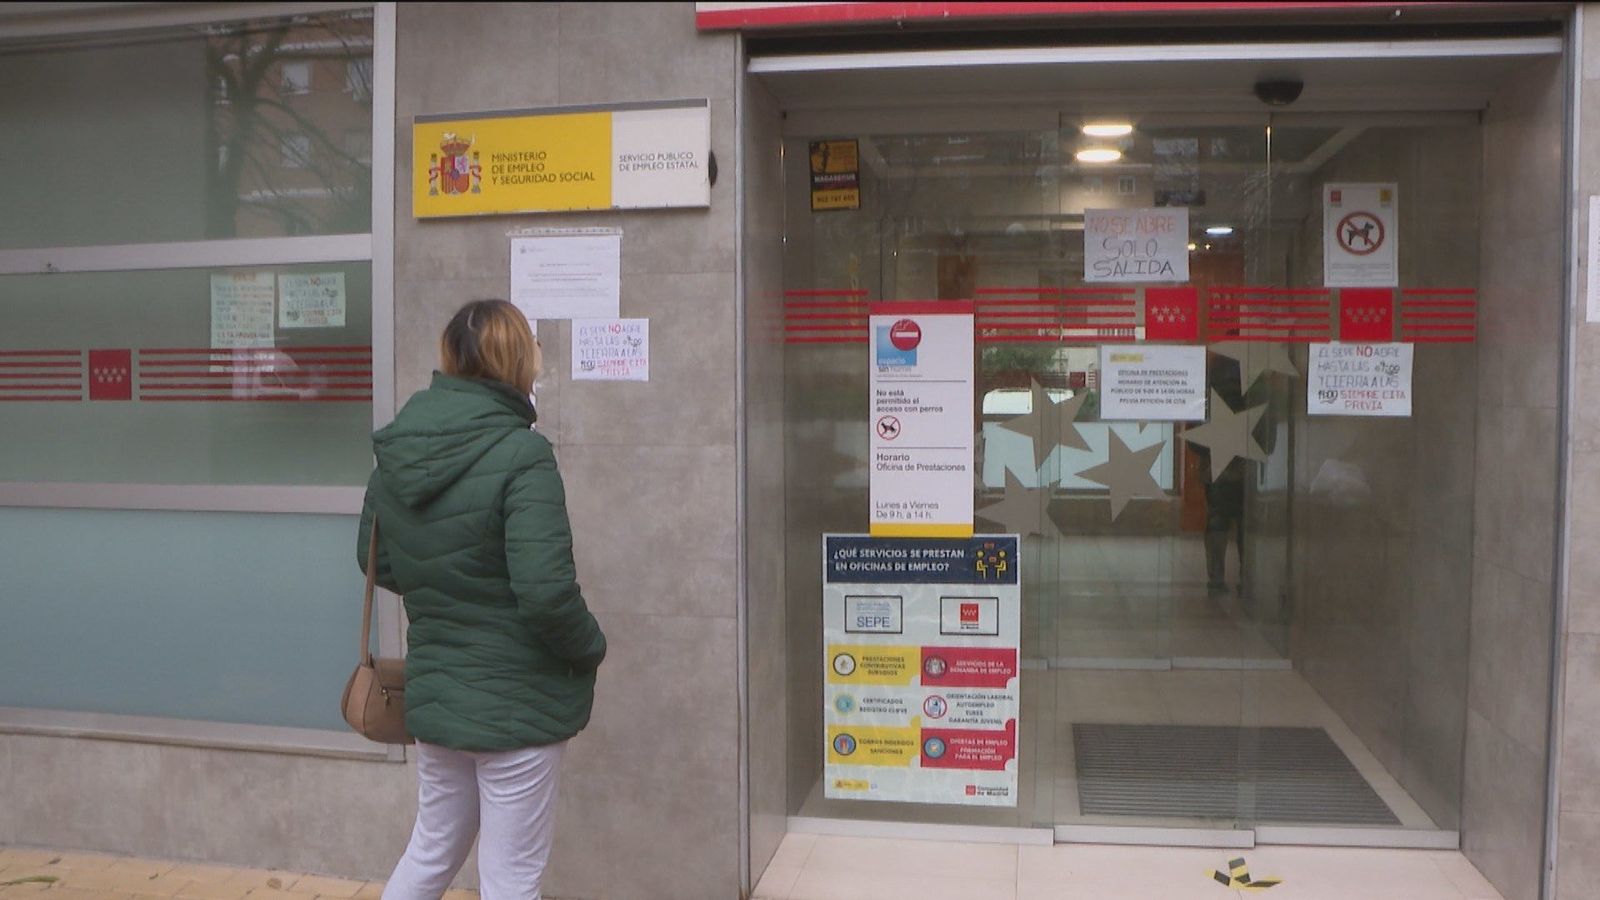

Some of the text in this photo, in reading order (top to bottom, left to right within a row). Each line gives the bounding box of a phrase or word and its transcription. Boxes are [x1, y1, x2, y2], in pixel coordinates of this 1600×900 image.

[491, 151, 547, 163] MINISTERIO
[618, 153, 655, 163] SERVICIO
[491, 162, 545, 175] DE EMPLEO
[618, 159, 700, 172] DE EMPLEO ESTATAL
[491, 171, 596, 185] Y SEGURIDAD SOCIAL
[1136, 215, 1176, 233] ABRE
[1103, 236, 1158, 261] SOLO
[1093, 259, 1175, 278] SALIDA
[608, 323, 621, 335] NO
[1318, 347, 1329, 358] EL
[1356, 345, 1373, 358] NO
[1374, 347, 1400, 358] ABRE
[1318, 361, 1350, 372] HASTA
[1352, 361, 1370, 372] LAS
[888, 389, 905, 397] está
[1382, 390, 1407, 399] CITA
[876, 397, 911, 406] permitido
[1344, 400, 1383, 410] PREVIA
[919, 406, 944, 414] perros
[876, 453, 910, 462] Horario
[876, 463, 966, 472] Oficina de Prestaciones
[876, 501, 901, 509] Lunes
[909, 501, 939, 510] Viernes
[876, 510, 888, 519] De
[889, 510, 895, 519] 9
[914, 510, 924, 519] 14
[833, 547, 965, 559] ¿QUÉ SERVICIOS SE PRESTAN
[835, 562, 950, 572] EN OFICINAS DE EMPLEO?
[856, 616, 891, 629] SEPE
[945, 692, 986, 700] ORIENTACIÓN
